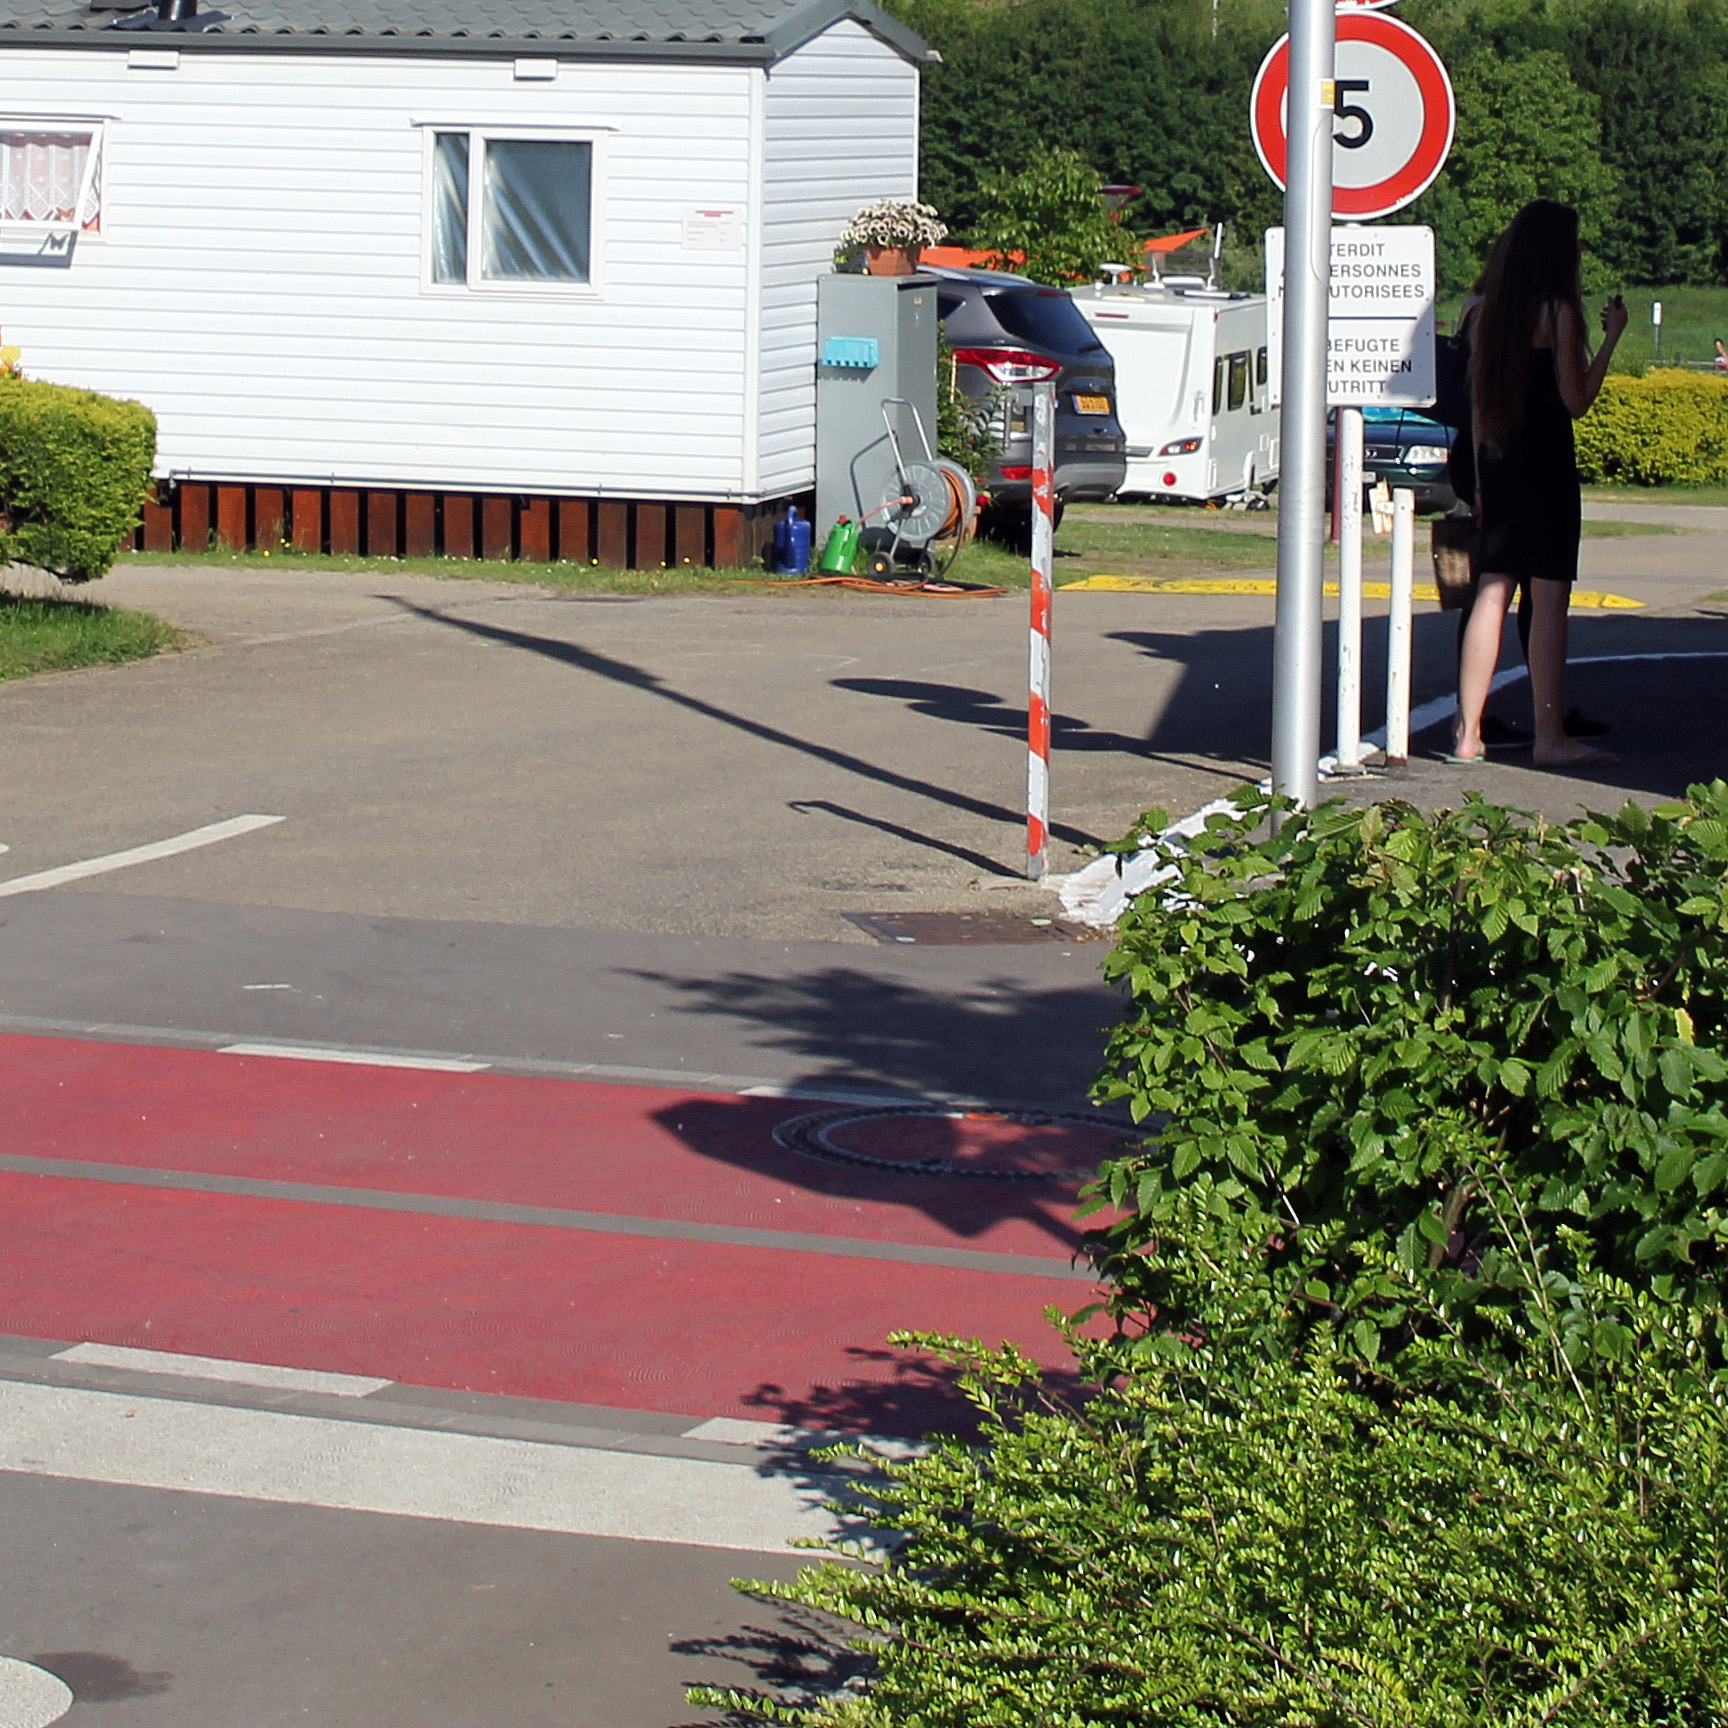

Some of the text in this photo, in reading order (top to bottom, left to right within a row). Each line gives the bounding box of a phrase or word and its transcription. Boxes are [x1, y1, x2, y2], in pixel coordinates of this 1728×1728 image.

[1333, 80, 1374, 149] 5
[1329, 243, 1387, 258] TERDIT
[1330, 263, 1422, 278] ERSONNES
[1329, 284, 1426, 299] UTORISEES
[1350, 360, 1413, 373] KEINEN
[1328, 380, 1387, 394] UTRITT
